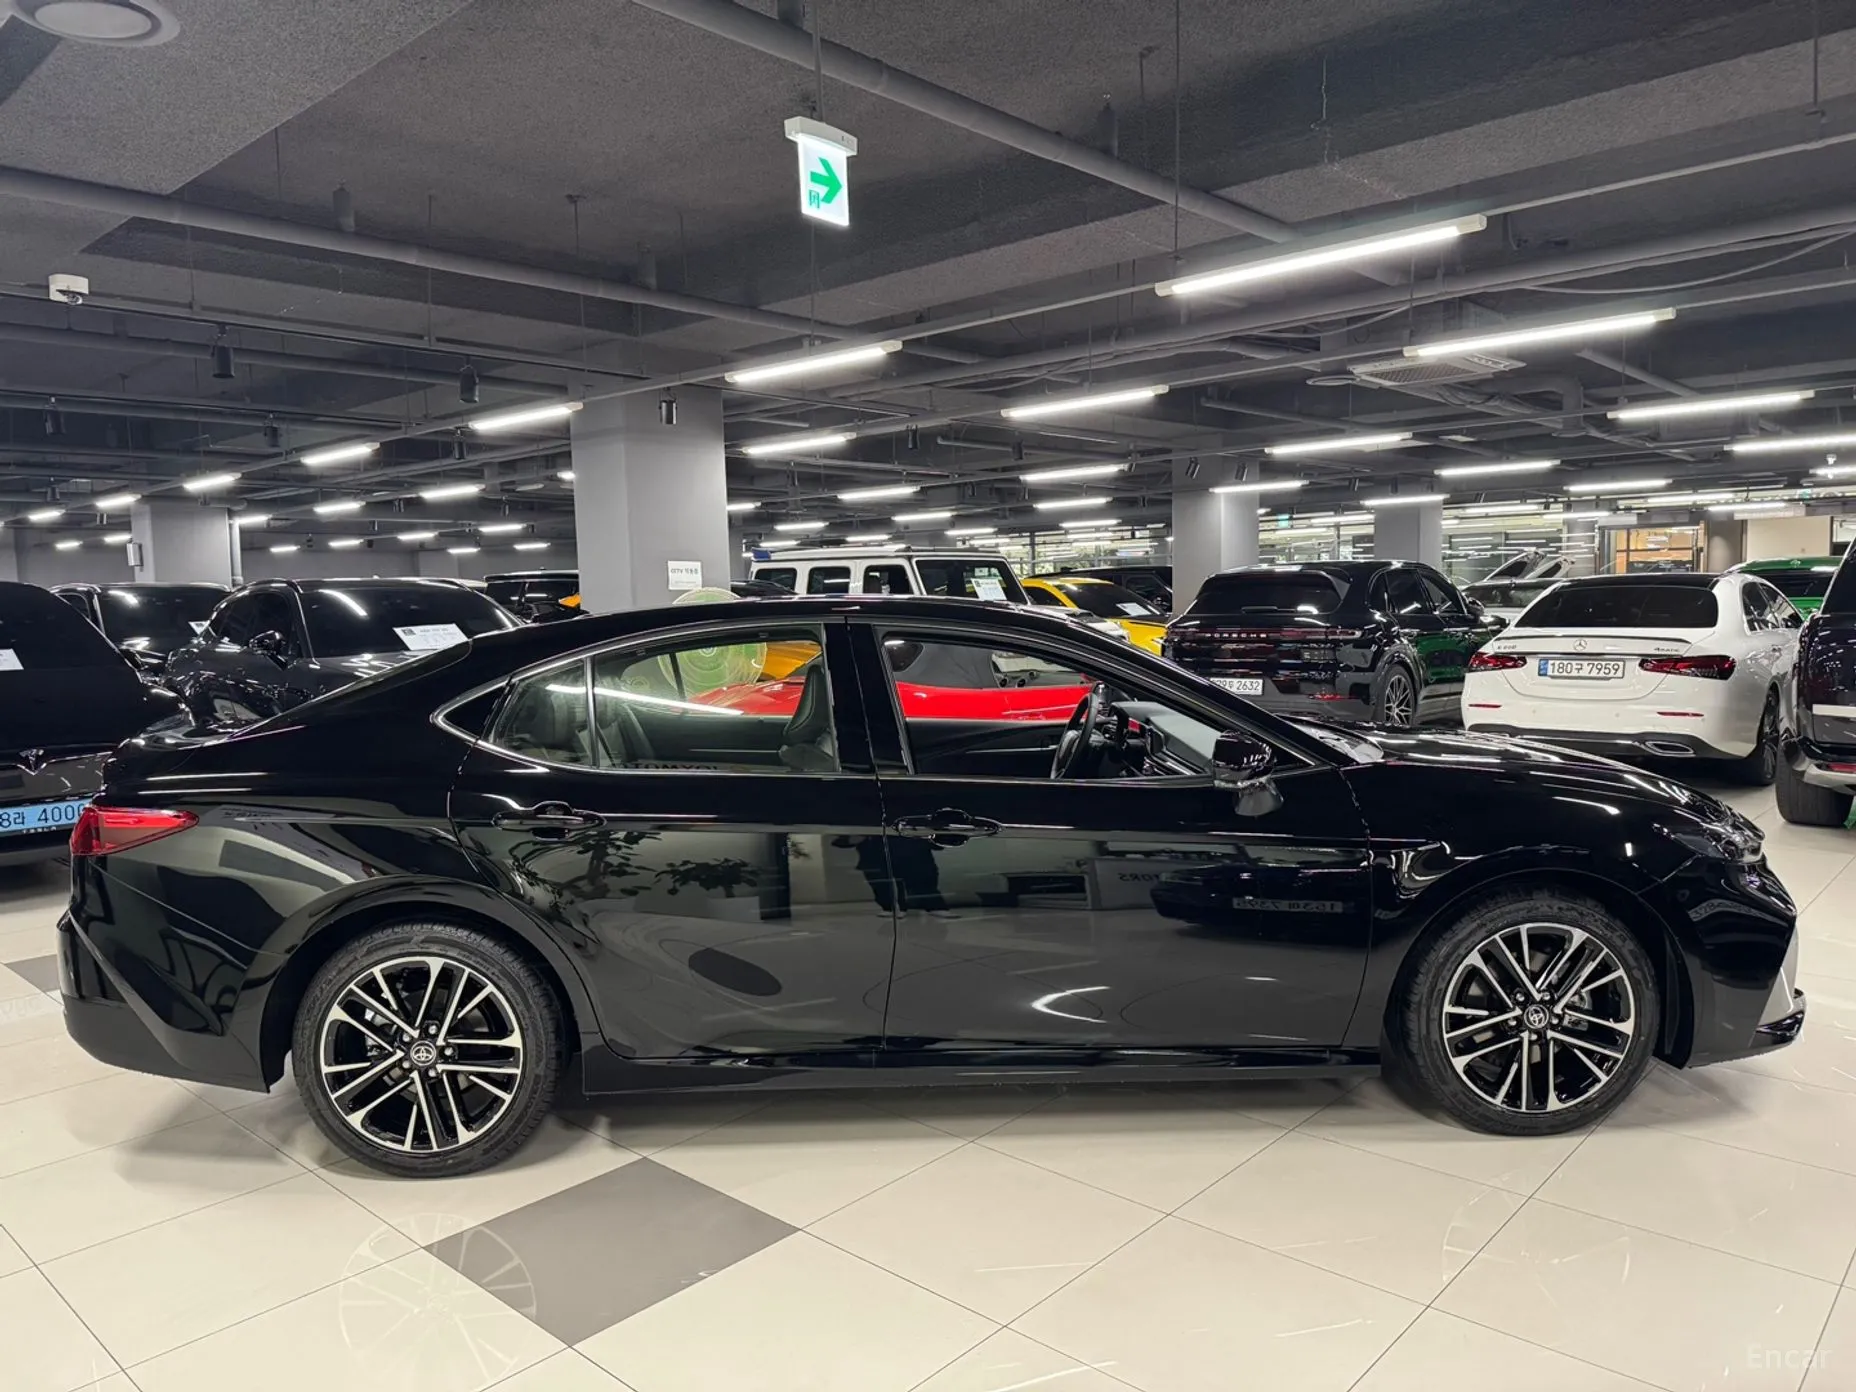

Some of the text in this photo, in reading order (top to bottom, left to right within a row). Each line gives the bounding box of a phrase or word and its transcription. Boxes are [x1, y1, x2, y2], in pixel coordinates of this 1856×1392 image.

[1550, 662, 1583, 674] 180구
[1587, 663, 1620, 675] 7959
[1236, 681, 1260, 691] 2632
